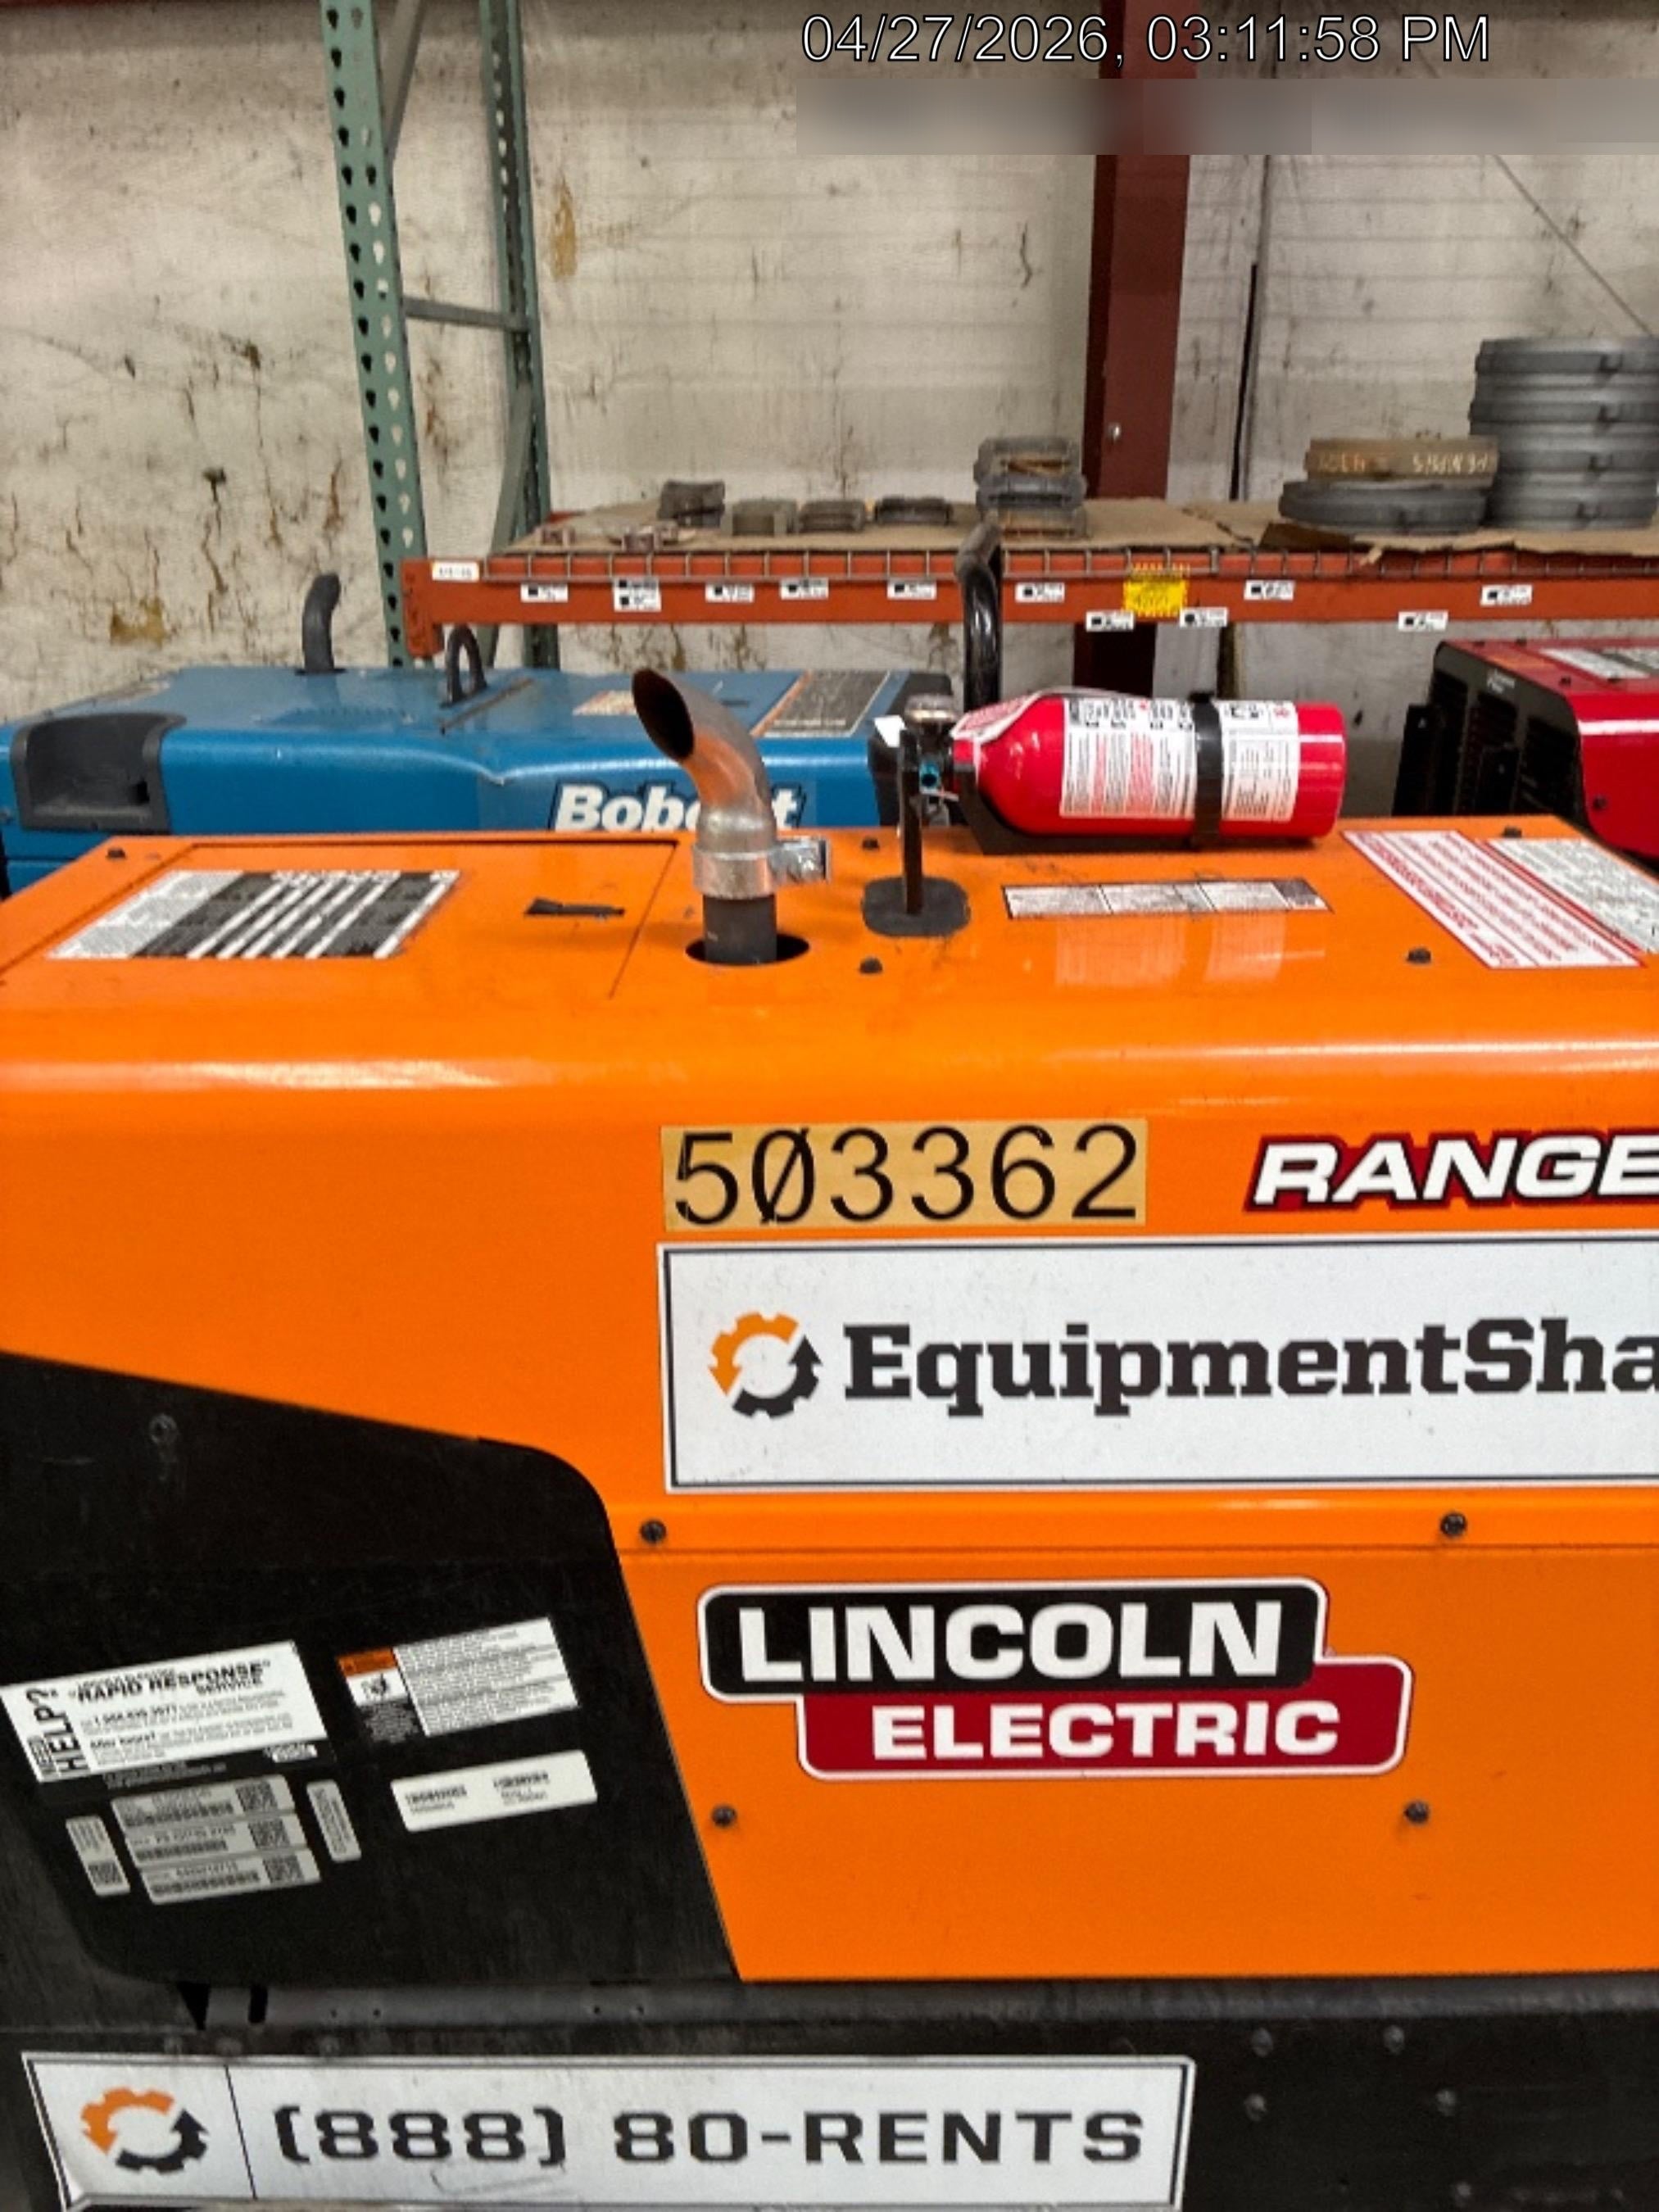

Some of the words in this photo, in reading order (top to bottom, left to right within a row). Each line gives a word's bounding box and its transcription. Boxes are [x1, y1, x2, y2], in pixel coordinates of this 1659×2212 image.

[555, 786, 800, 835] Bobt
[675, 1124, 1137, 1226] 503362
[843, 1318, 1659, 1417] EquipmentSha
[739, 1602, 1281, 1682] LINCOLN
[872, 1700, 1339, 1760] ELECTRIC
[274, 2105, 566, 2167] (888)
[614, 2113, 1142, 2162] 80-RENTS
